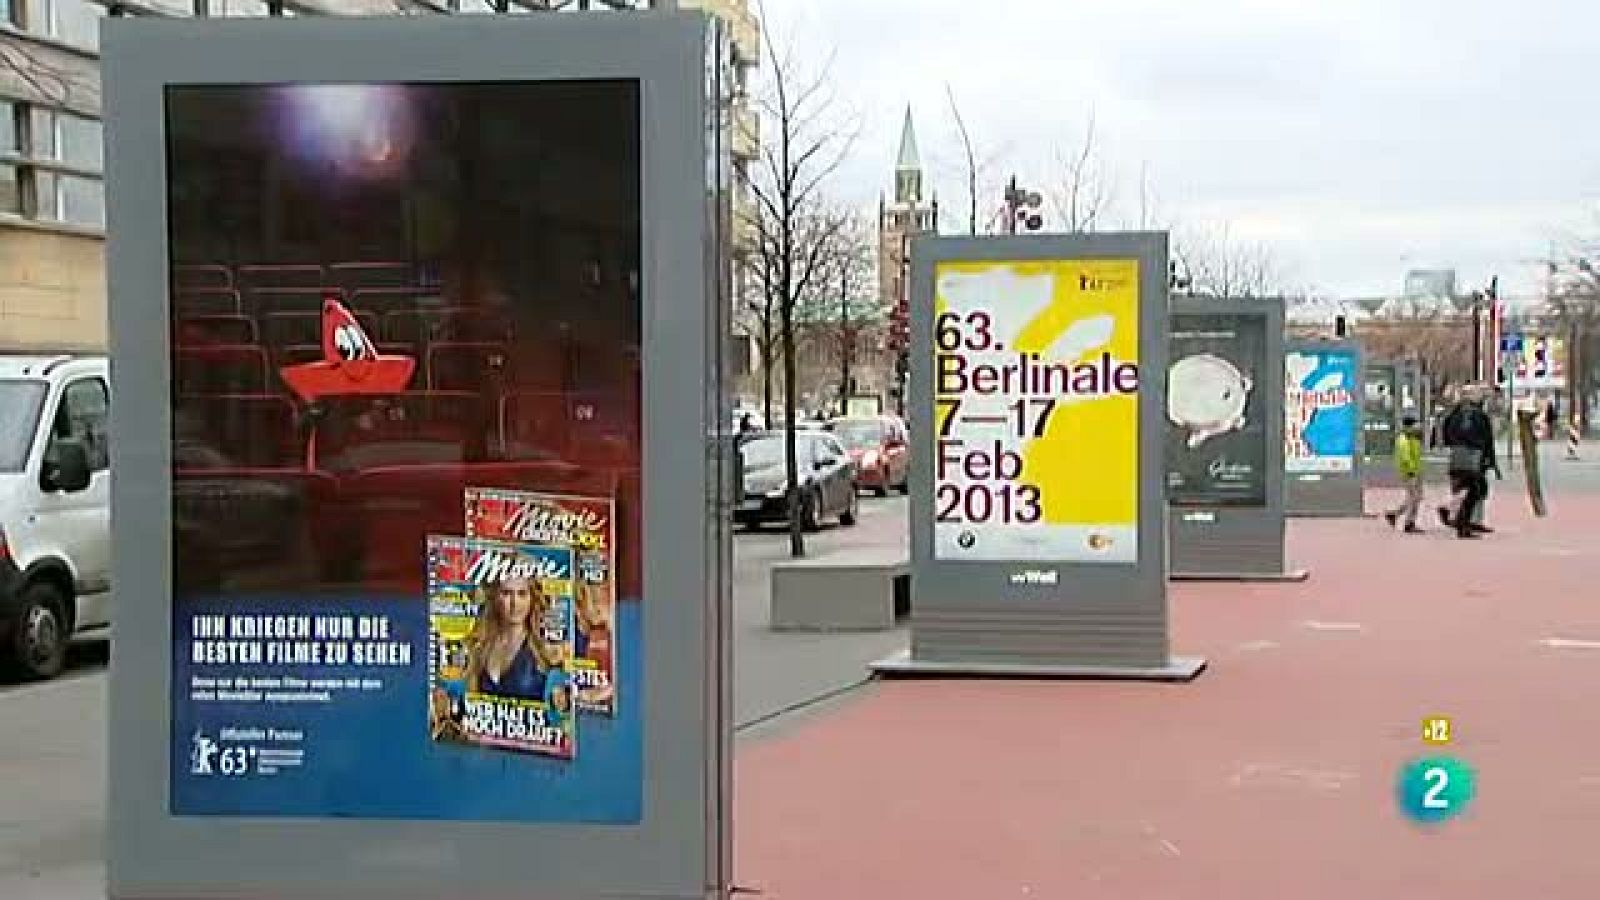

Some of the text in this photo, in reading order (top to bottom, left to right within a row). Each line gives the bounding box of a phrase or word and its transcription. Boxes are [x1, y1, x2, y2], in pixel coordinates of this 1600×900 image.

[936, 311, 1004, 352] 63.
[936, 352, 1139, 394] Berlinale
[937, 440, 1023, 481] Feb
[501, 501, 607, 536] Movie
[936, 484, 1042, 524] 2013
[465, 549, 566, 584] Movie
[192, 615, 390, 639] IHN KRIEGEN NUR DIE
[192, 641, 412, 666] BESTEN FILME ZU SEHEN
[463, 715, 503, 738] NOCH
